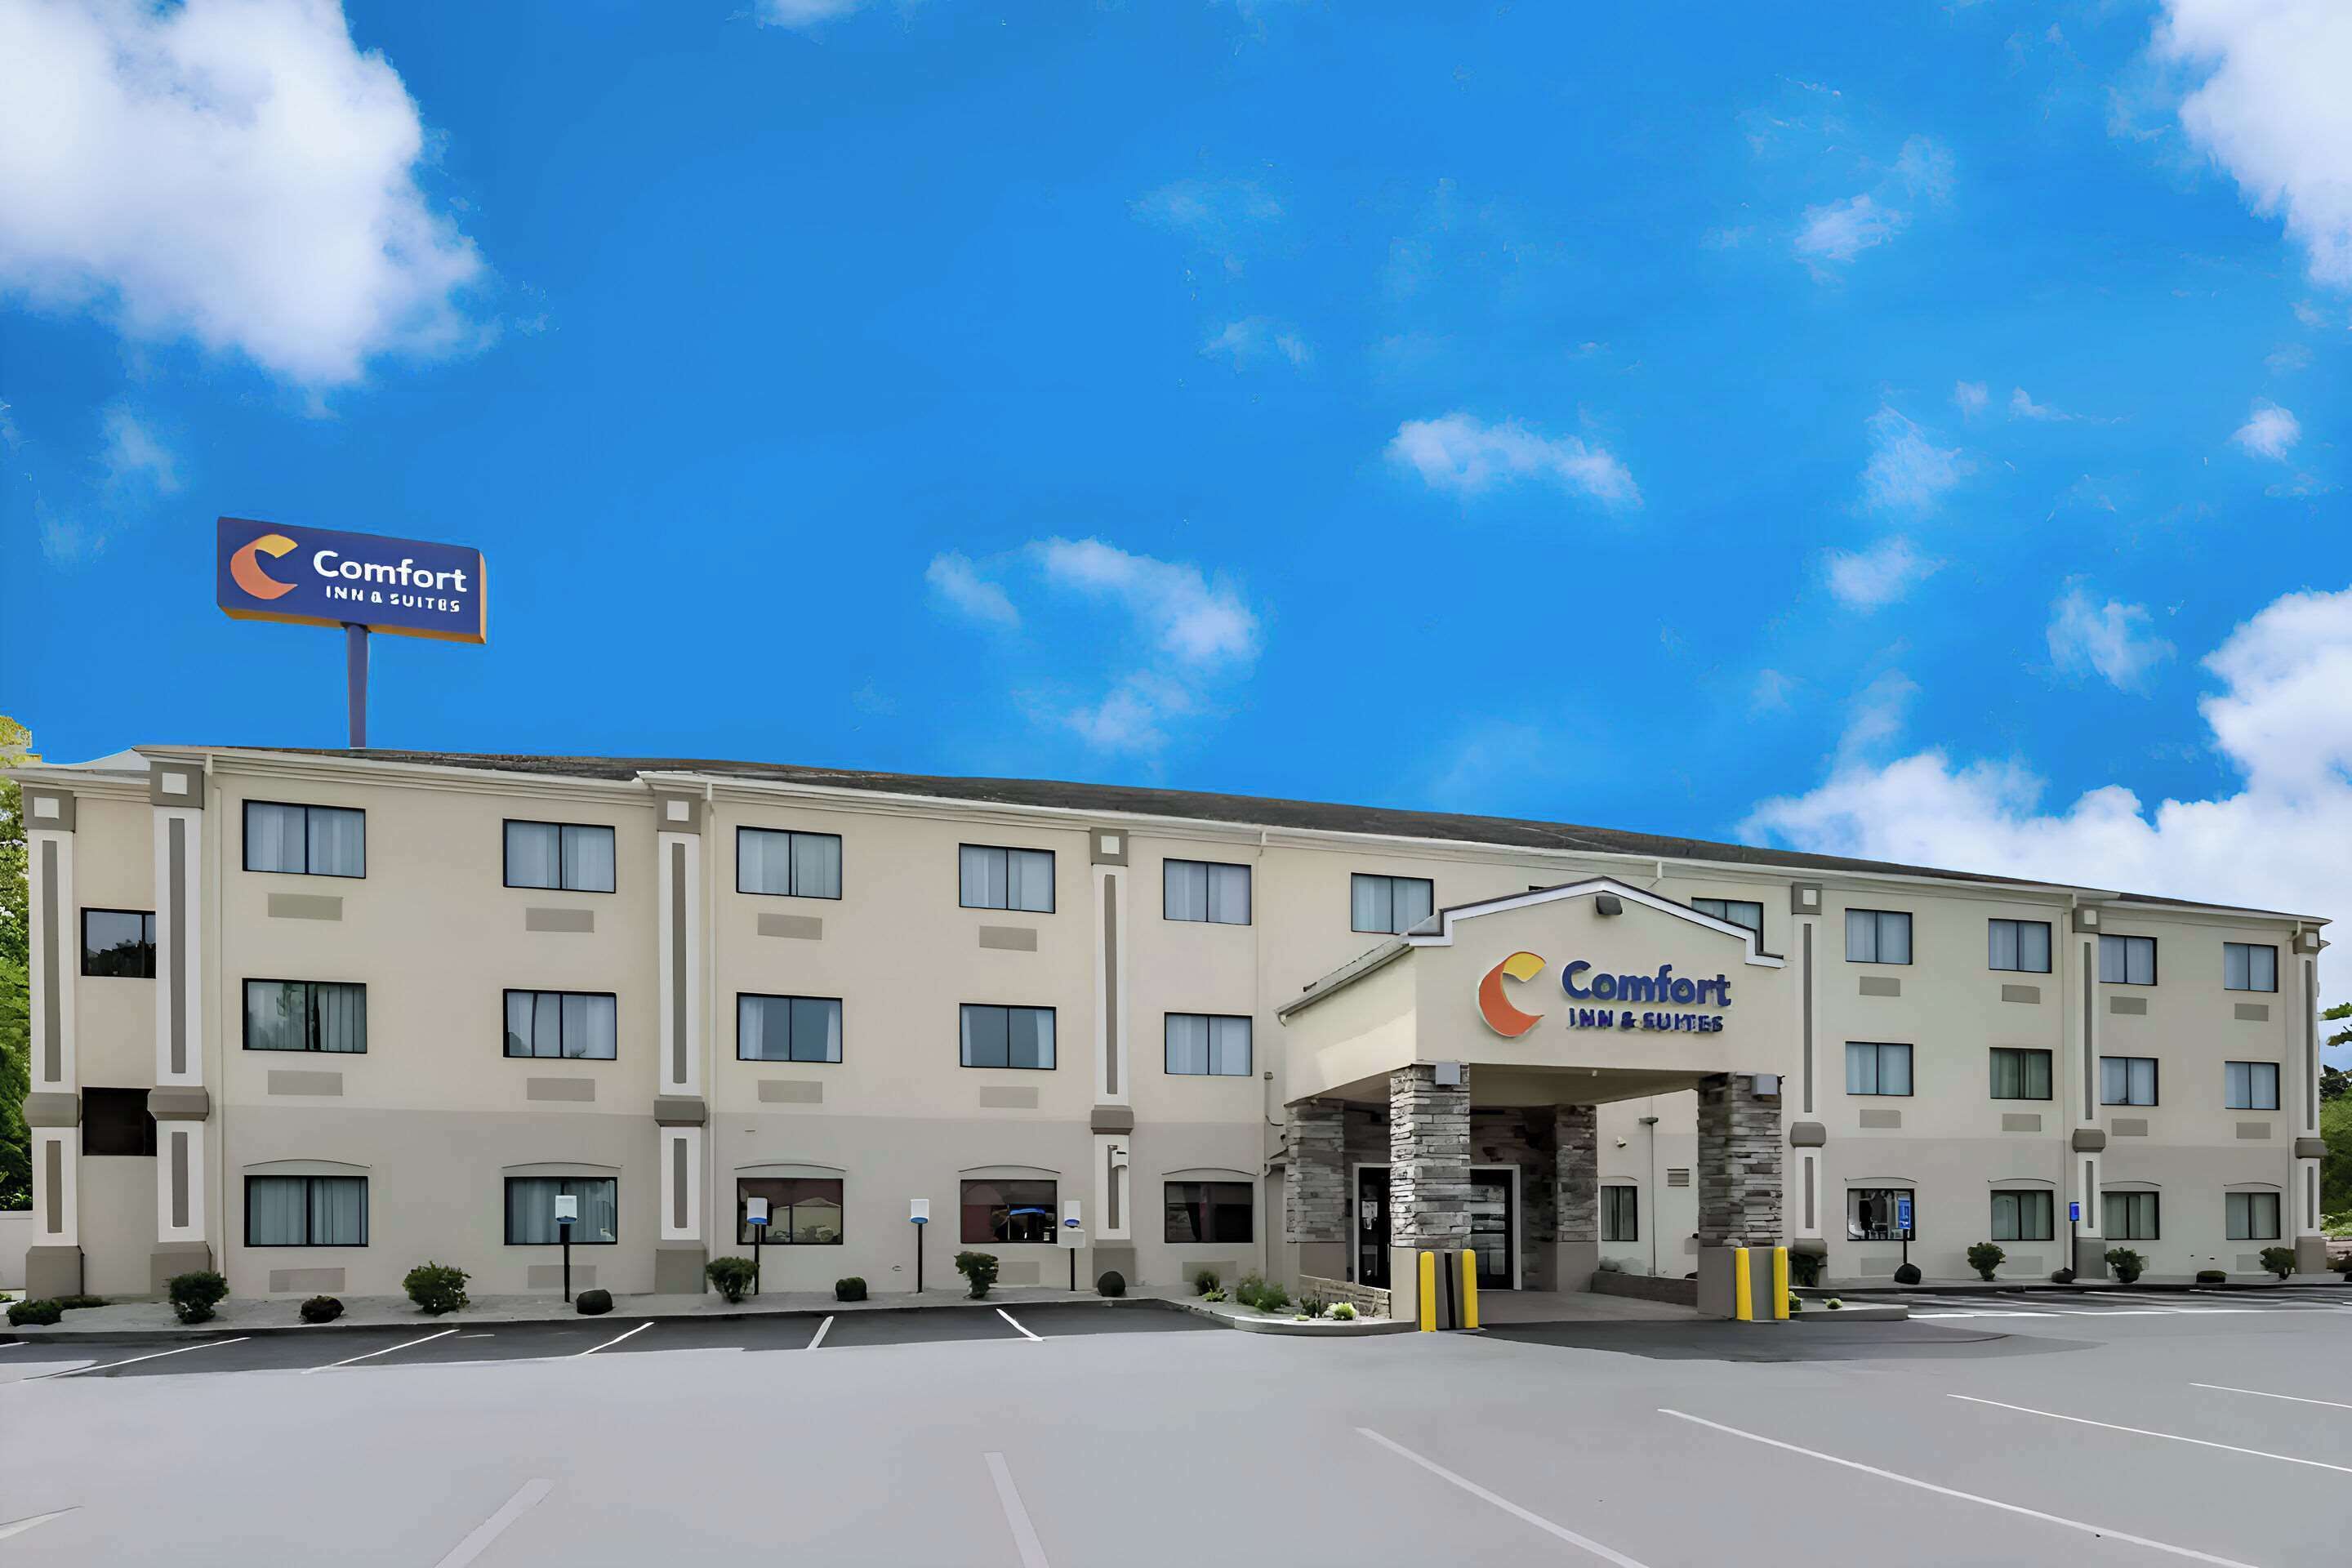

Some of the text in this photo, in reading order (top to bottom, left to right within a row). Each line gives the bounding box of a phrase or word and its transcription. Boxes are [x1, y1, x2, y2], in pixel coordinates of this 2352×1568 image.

[313, 550, 467, 592] Comfort
[326, 585, 363, 602] INN
[371, 590, 383, 604] &
[1561, 960, 1732, 1007] Comfort
[1569, 1007, 1724, 1033] INN & SUITES
